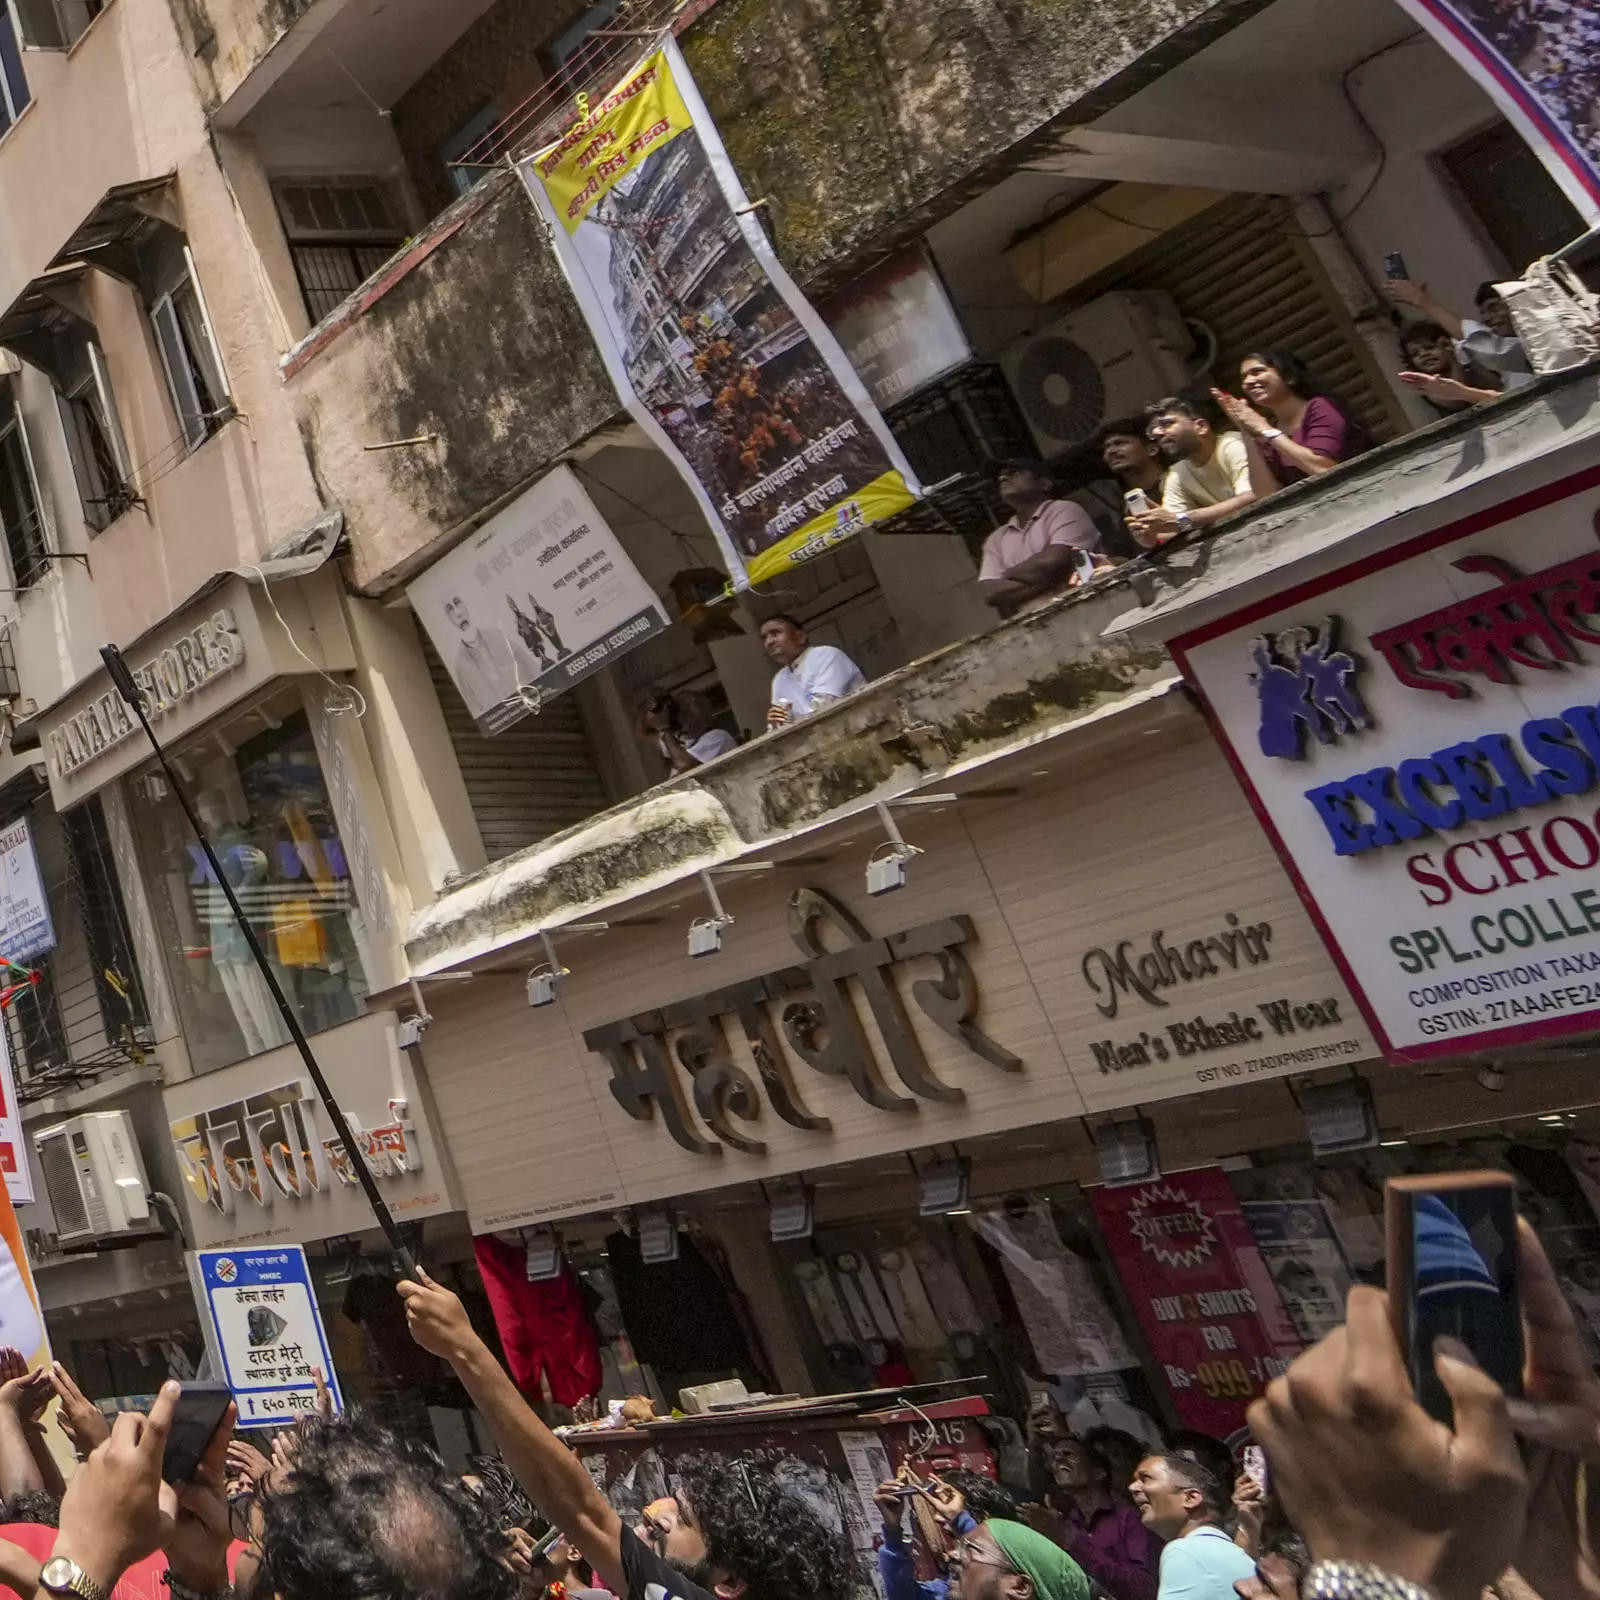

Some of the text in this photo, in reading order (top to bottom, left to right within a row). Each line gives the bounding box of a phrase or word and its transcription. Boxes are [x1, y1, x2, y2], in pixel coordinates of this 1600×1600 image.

[49, 607, 247, 780] JANATA STORES
[1082, 912, 1272, 1018] Mahavir
[1408, 960, 1546, 1009] COMPOSITION
[582, 887, 1022, 1155] महावीर
[1089, 997, 1343, 1076] Men's Ethnic Wear
[1418, 1007, 1483, 1036] GSTIN:
[1141, 1212, 1200, 1238] OFFER
[1151, 1295, 1184, 1321] BUY
[1196, 1287, 1257, 1316] SHIRTS
[247, 1342, 304, 1365] दादर मेट्रो
[244, 1367, 277, 1381] स्थानक
[278, 1365, 294, 1382] पुढे
[1197, 1359, 1253, 1397] 999
[262, 1391, 315, 1412] ६५० मीटर
